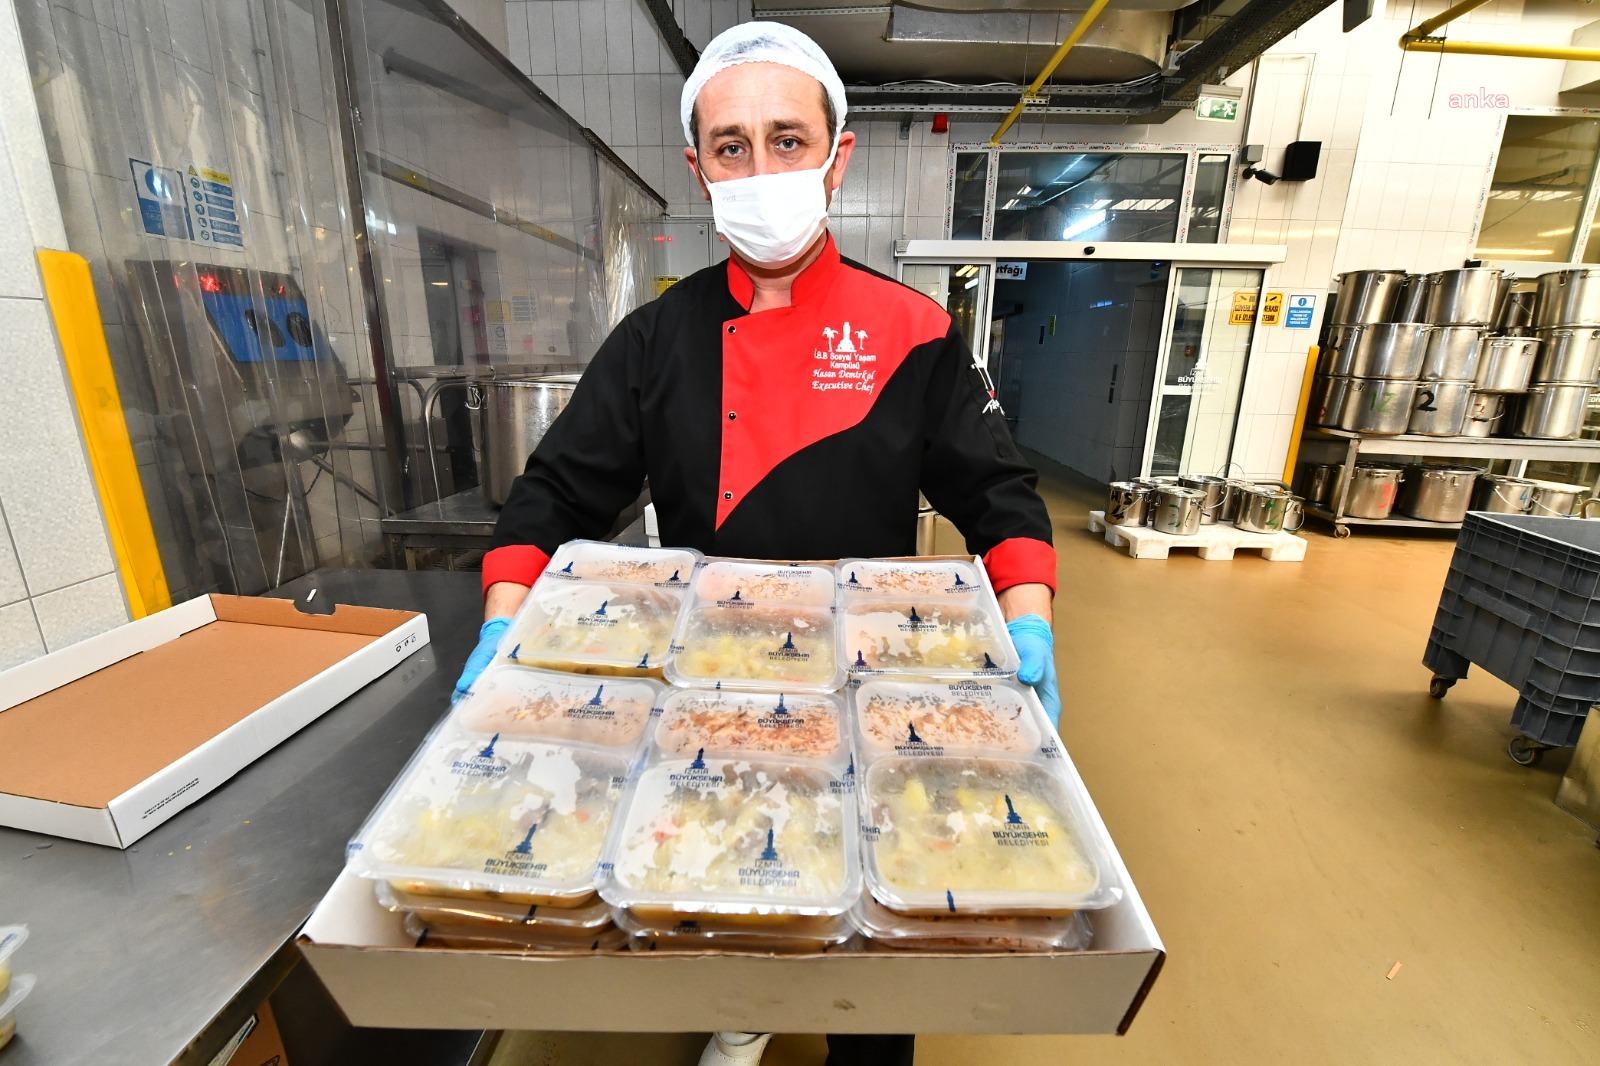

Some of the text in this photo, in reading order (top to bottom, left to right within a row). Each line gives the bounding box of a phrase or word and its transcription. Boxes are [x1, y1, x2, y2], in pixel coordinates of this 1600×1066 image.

[996, 264, 1023, 276] utfağı
[830, 352, 852, 362] Sosyal
[854, 353, 877, 363] Yaşam
[830, 361, 860, 370] Kampüsü
[813, 368, 836, 378] Hasan
[812, 381, 875, 395] Executive Chef
[1417, 390, 1437, 411] 2
[670, 774, 723, 782] BÜYÜKŞEHİR
[993, 831, 1049, 839] BÜYÜKŞEHİR
[486, 859, 547, 871] BÜYÜKŞEHİR
[738, 868, 800, 878] BÜYÜKŞEHİR
